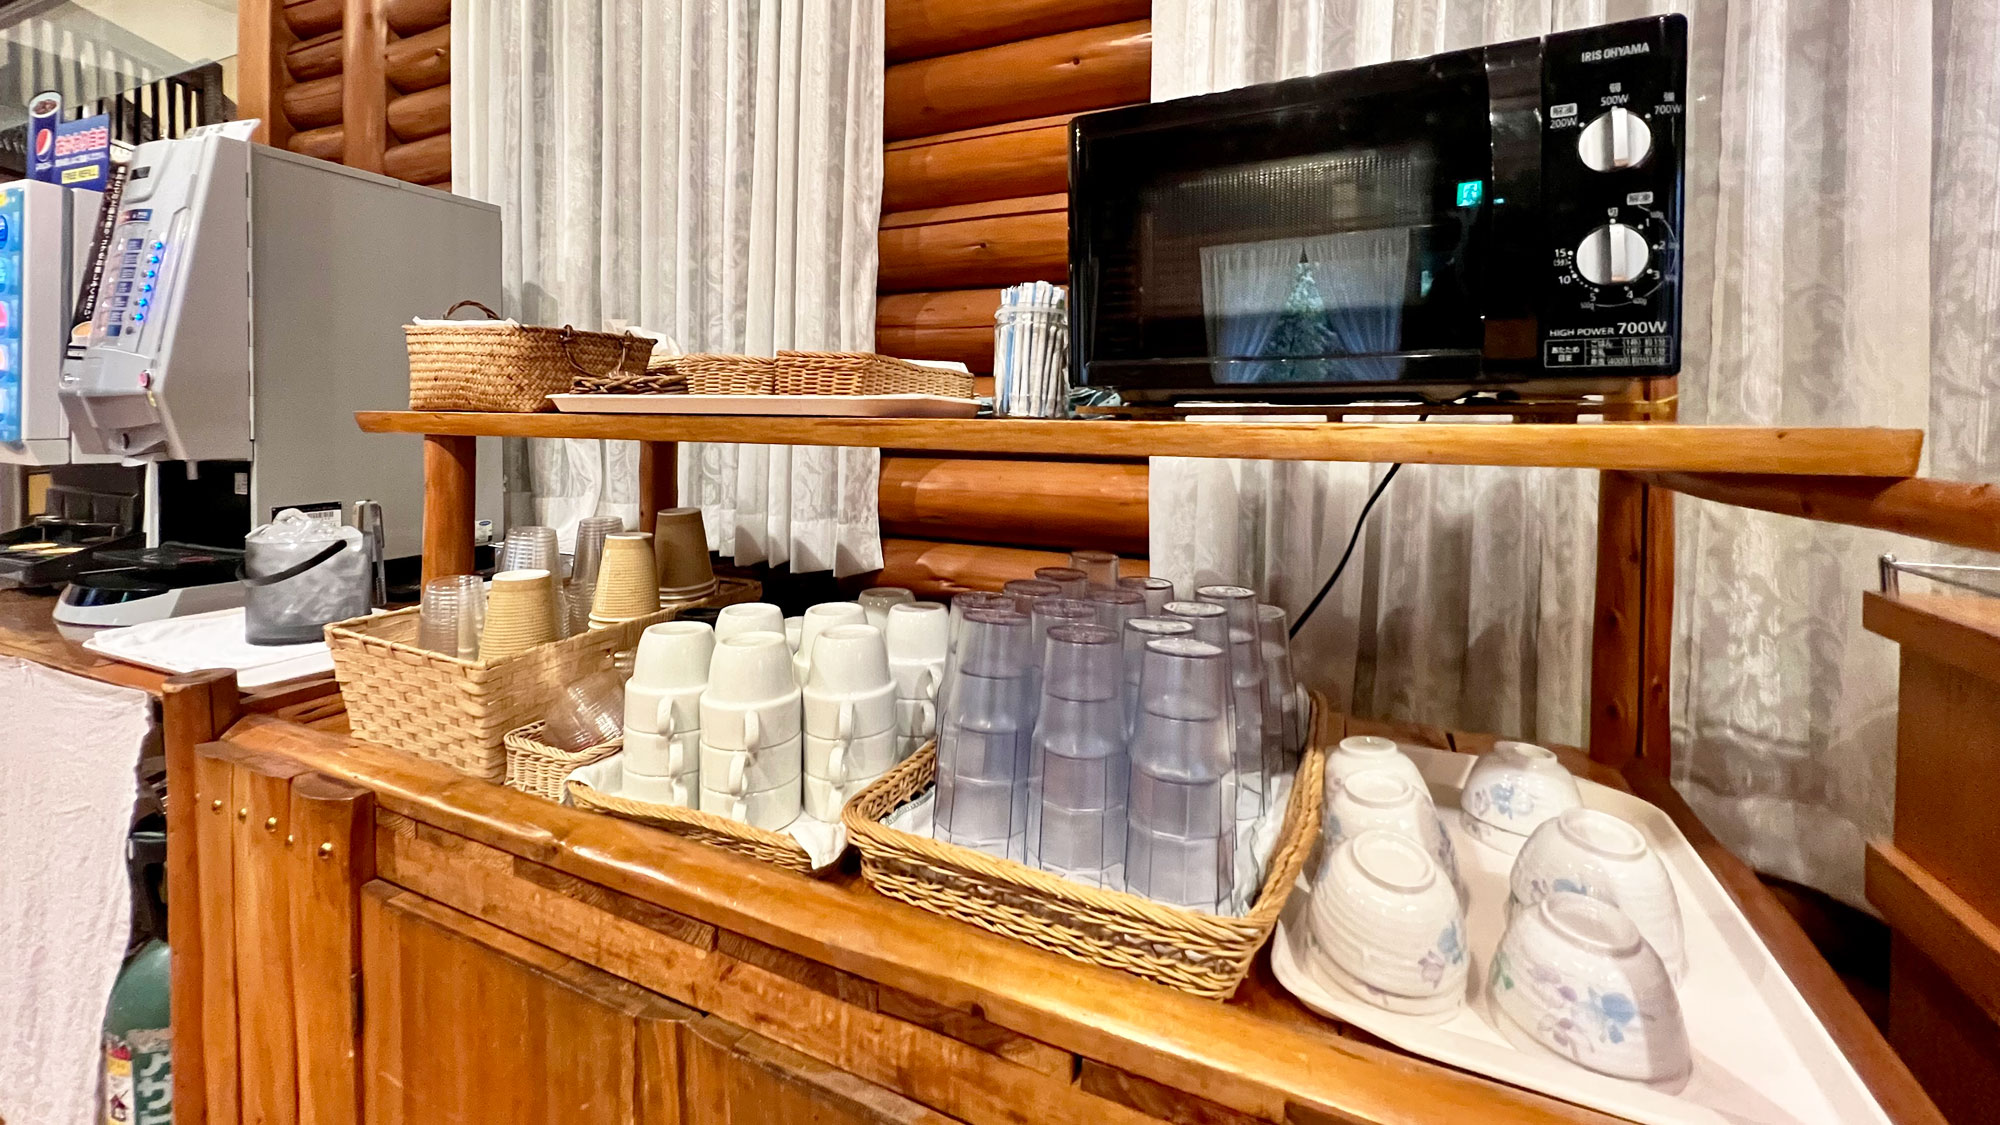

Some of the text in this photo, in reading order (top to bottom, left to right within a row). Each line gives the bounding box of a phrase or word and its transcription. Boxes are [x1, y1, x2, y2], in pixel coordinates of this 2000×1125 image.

[1581, 42, 1650, 63] IRIS OHYAMA
[1600, 94, 1629, 106] 500W
[1654, 104, 1682, 115] 700W
[1550, 117, 1577, 129] 200W
[1645, 218, 1650, 227] 1
[1658, 240, 1666, 250] 2
[1554, 248, 1567, 257] 15
[1558, 275, 1571, 285] 10
[1652, 270, 1660, 280] 3
[1589, 293, 1597, 302] 5
[1626, 290, 1634, 299] 4
[1549, 320, 1667, 337] HIGH POWER 700W
[1551, 345, 1580, 354] あたため
